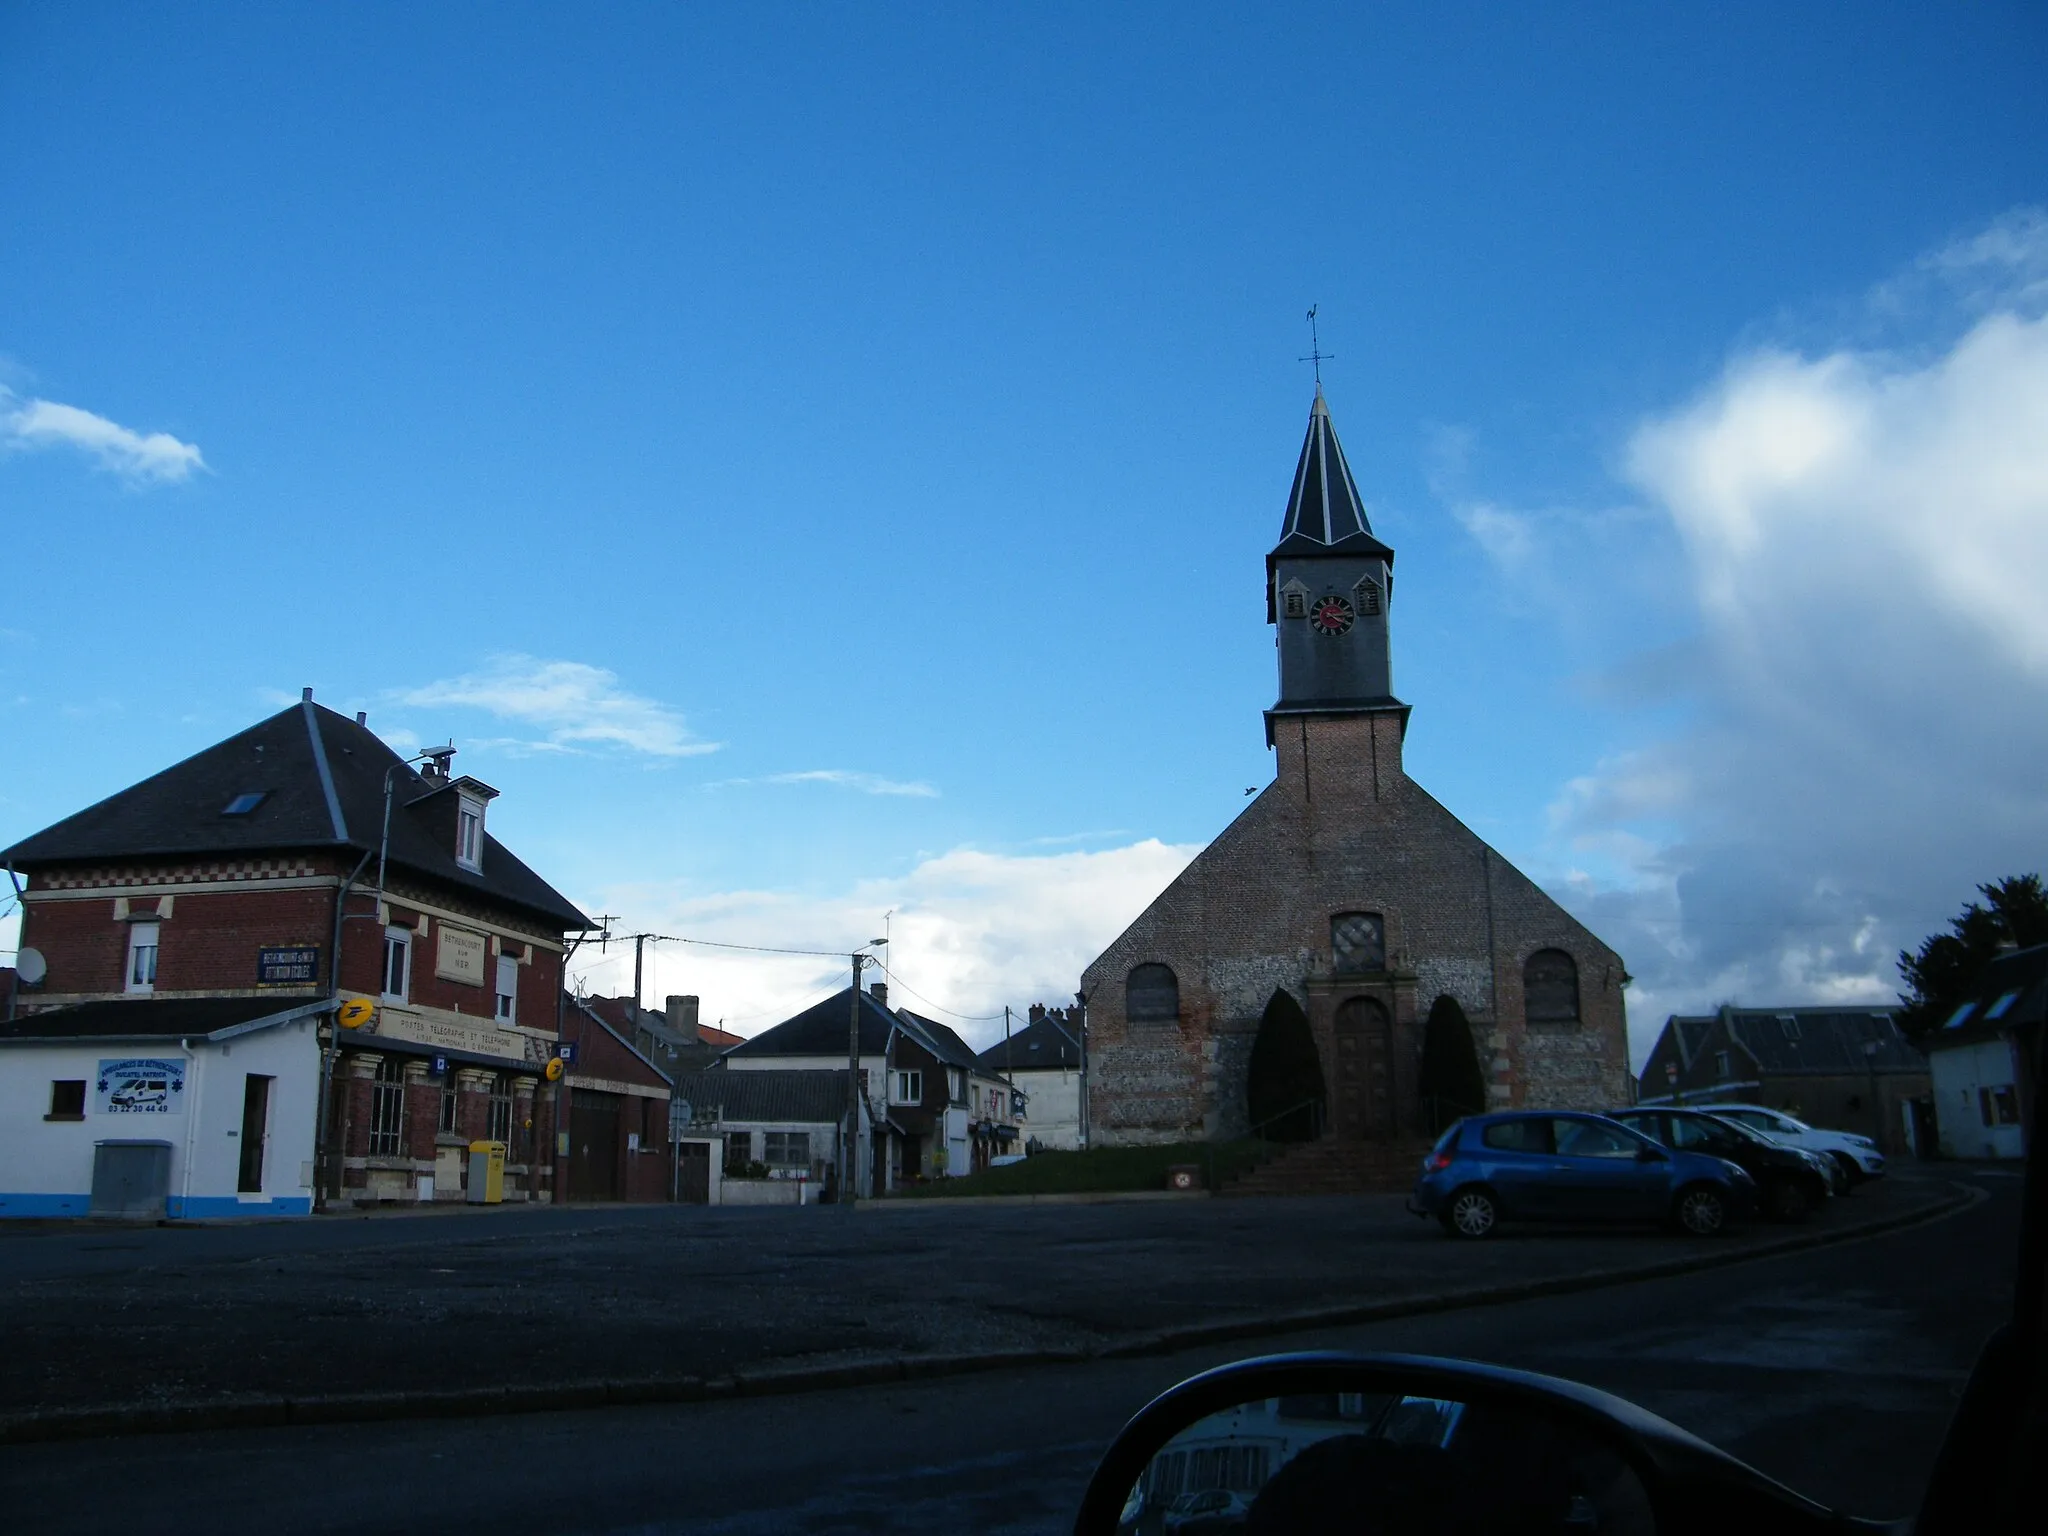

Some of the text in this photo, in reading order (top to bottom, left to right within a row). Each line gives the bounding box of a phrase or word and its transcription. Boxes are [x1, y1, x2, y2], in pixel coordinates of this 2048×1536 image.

[400, 1019, 424, 1032] POSTES
[470, 1032, 478, 1041] ET
[102, 1060, 136, 1077] AMBULANCES
[137, 1060, 145, 1068] DE
[108, 1105, 168, 1113] 03 22 30 44 49
